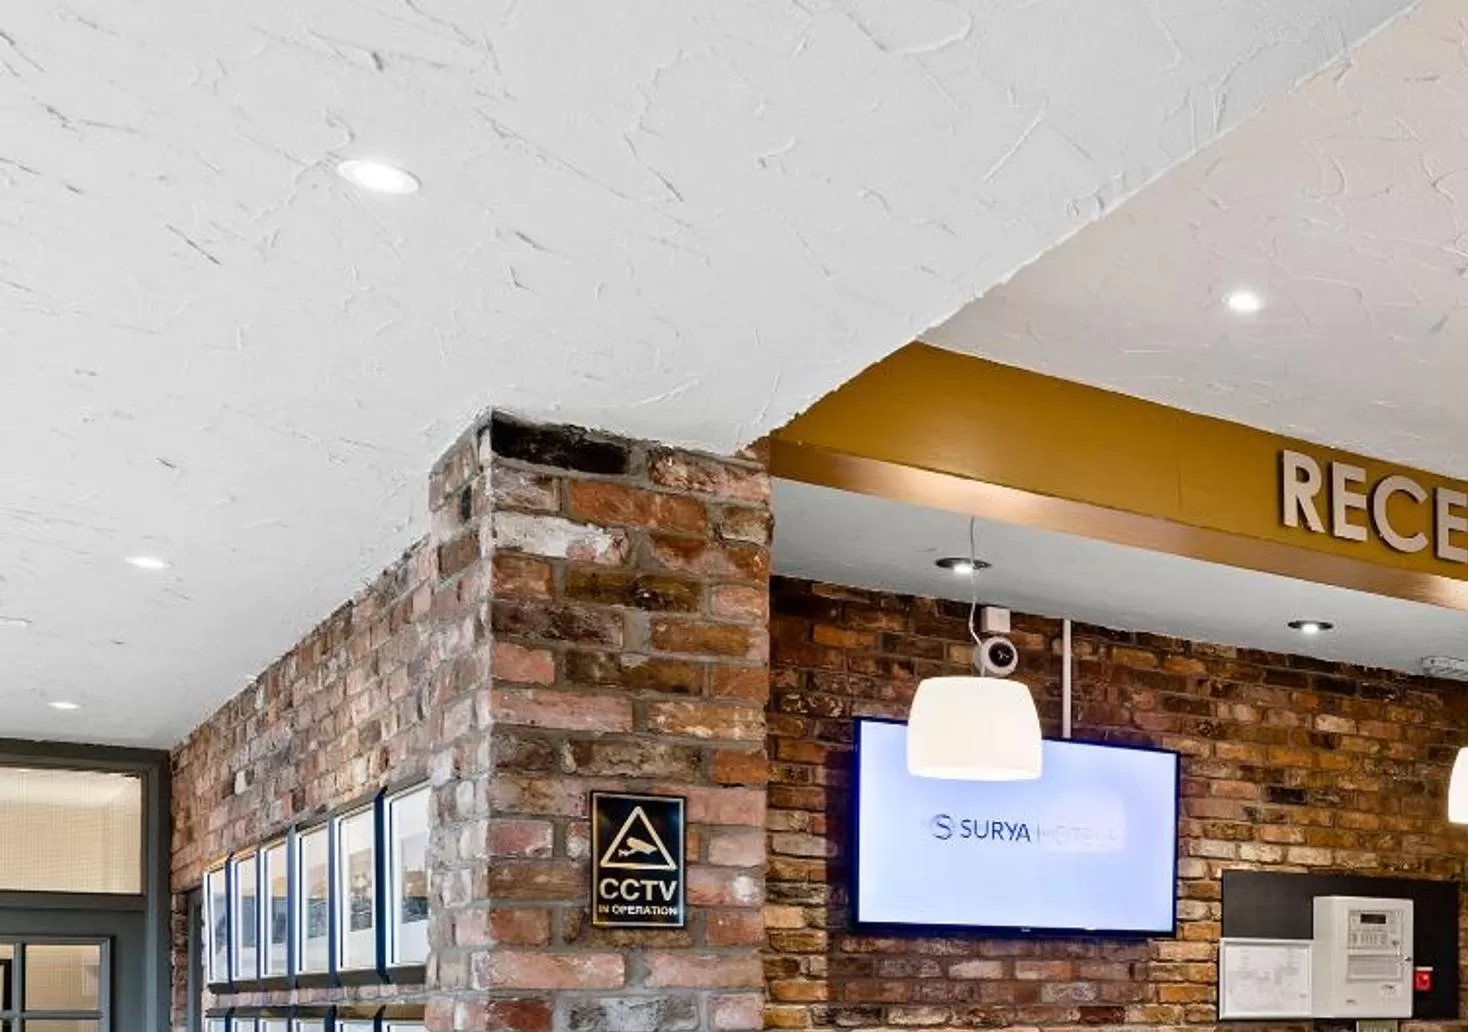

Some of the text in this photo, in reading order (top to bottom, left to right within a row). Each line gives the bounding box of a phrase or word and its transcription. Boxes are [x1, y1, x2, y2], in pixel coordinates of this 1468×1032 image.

[960, 818, 1031, 842] SURYA
[600, 878, 678, 901] CCTV
[599, 904, 678, 916] IN OPERATION
